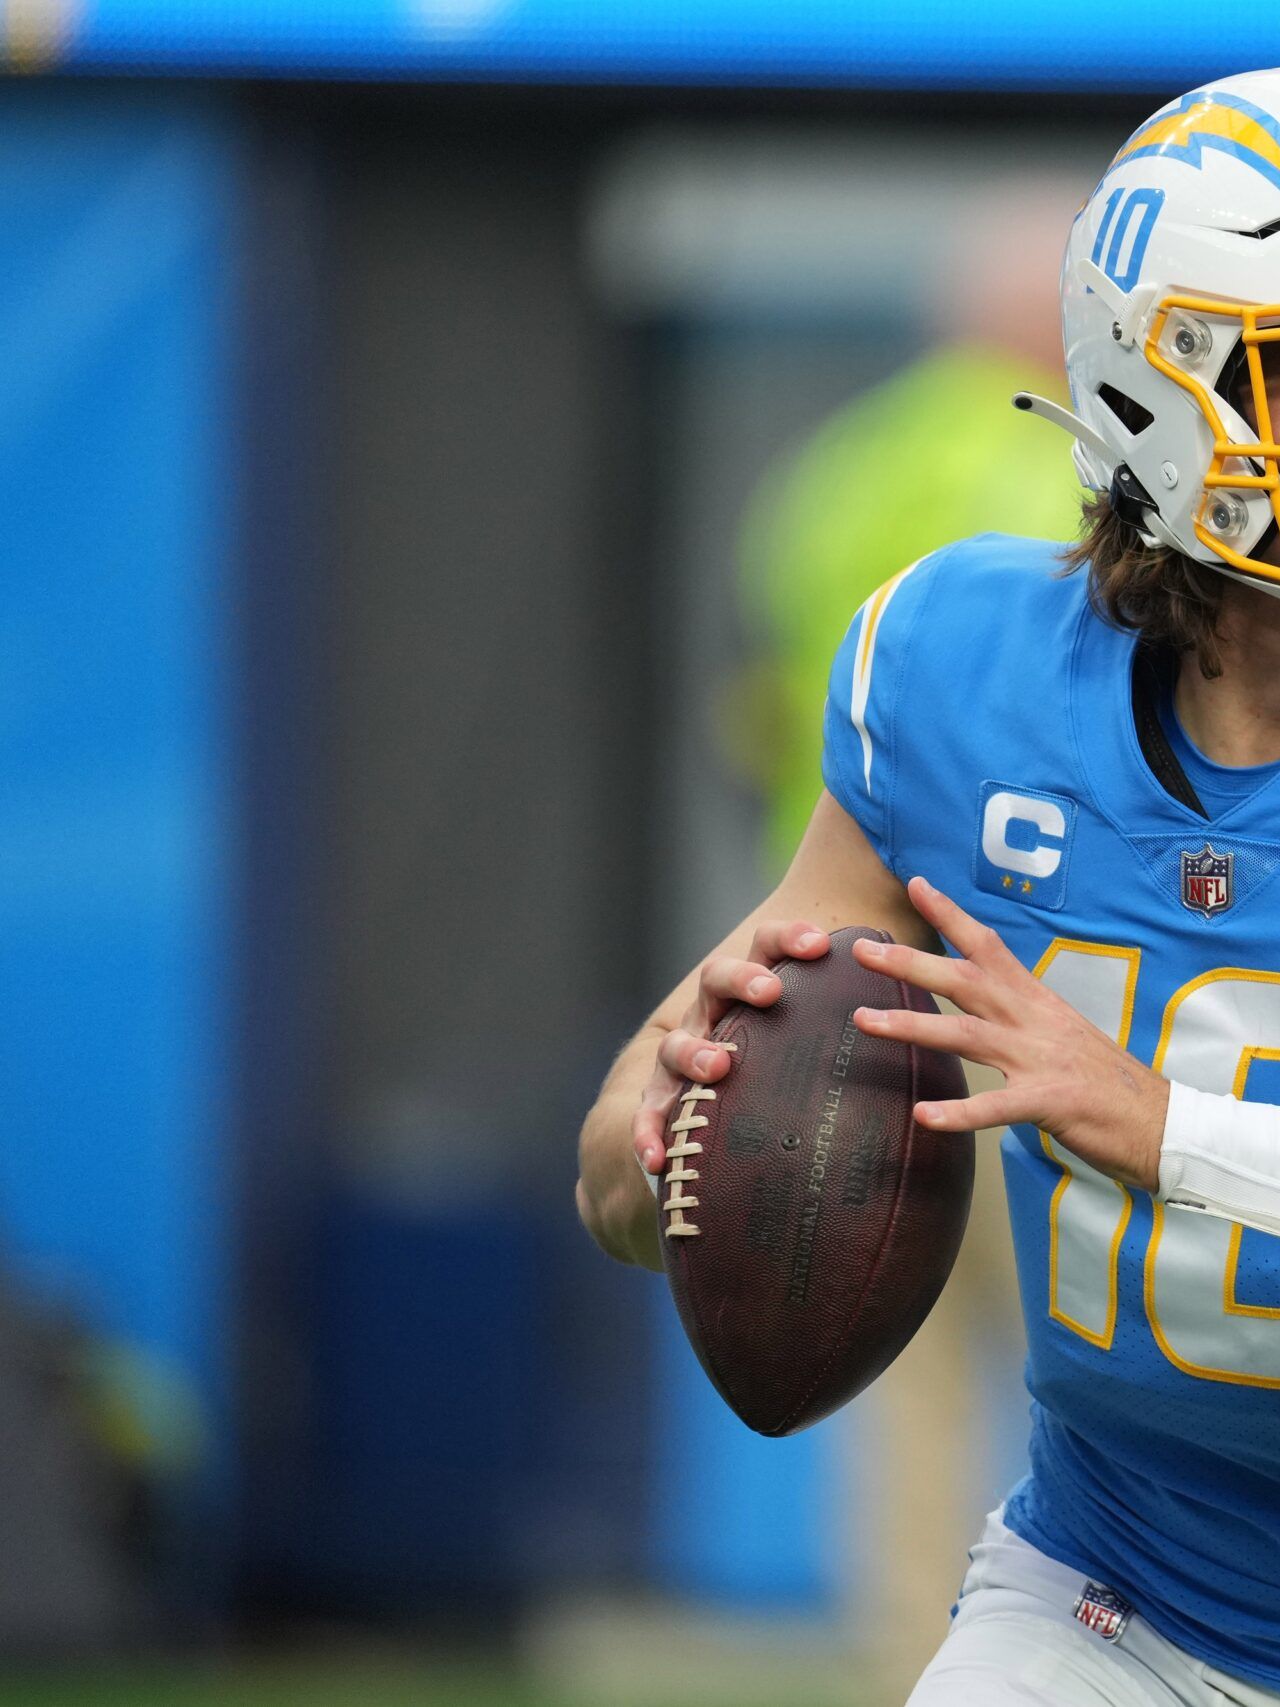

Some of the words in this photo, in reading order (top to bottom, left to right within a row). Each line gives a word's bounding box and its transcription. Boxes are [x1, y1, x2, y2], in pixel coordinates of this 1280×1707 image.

[1087, 188, 1165, 293] 10
[982, 791, 1066, 878] C
[1188, 877, 1225, 907] NFL
[789, 1201, 819, 1303] NATIONAL
[809, 1087, 842, 1192] FOOTBALL
[831, 1010, 858, 1077] LEAGU
[1079, 1602, 1117, 1634] NFL
